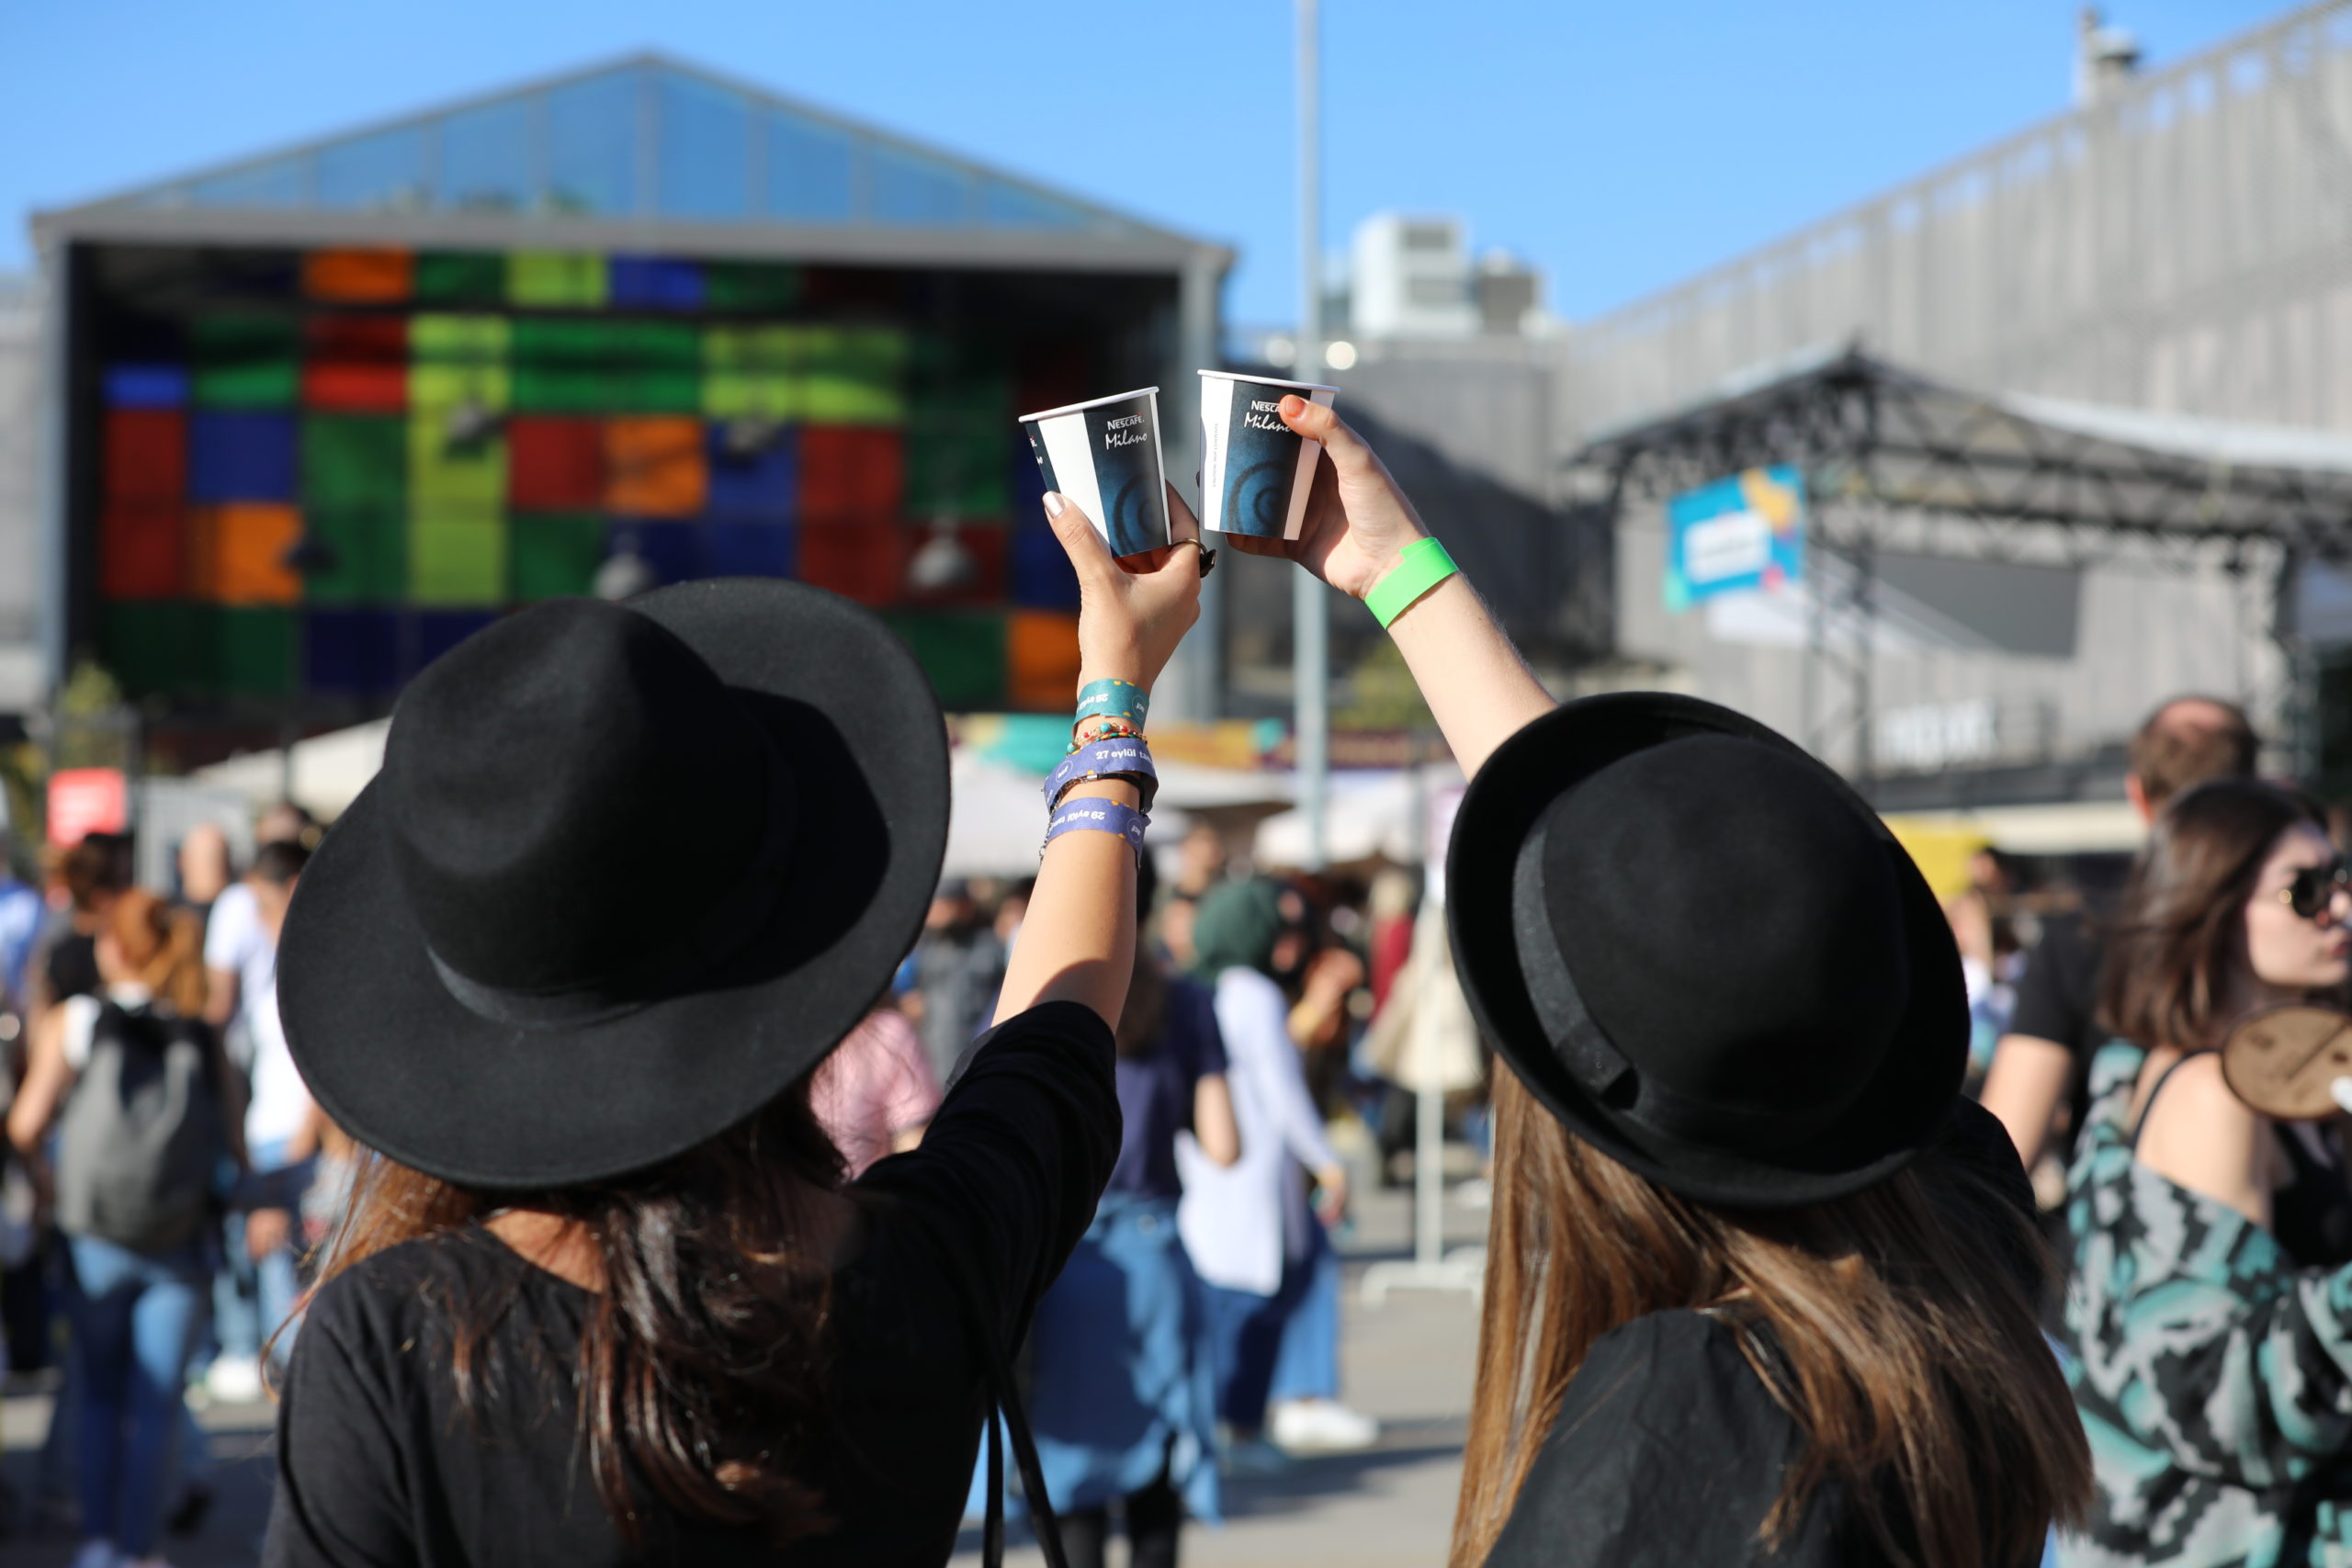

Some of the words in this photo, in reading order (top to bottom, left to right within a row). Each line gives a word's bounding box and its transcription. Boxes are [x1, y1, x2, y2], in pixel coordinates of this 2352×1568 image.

[1250, 400, 1280, 412] NESCA
[1105, 429, 1148, 450] Milano
[1096, 750, 1109, 761] 27
[1111, 748, 1136, 759] eylül
[1067, 810, 1090, 822] eylül
[1090, 811, 1105, 820] 29
